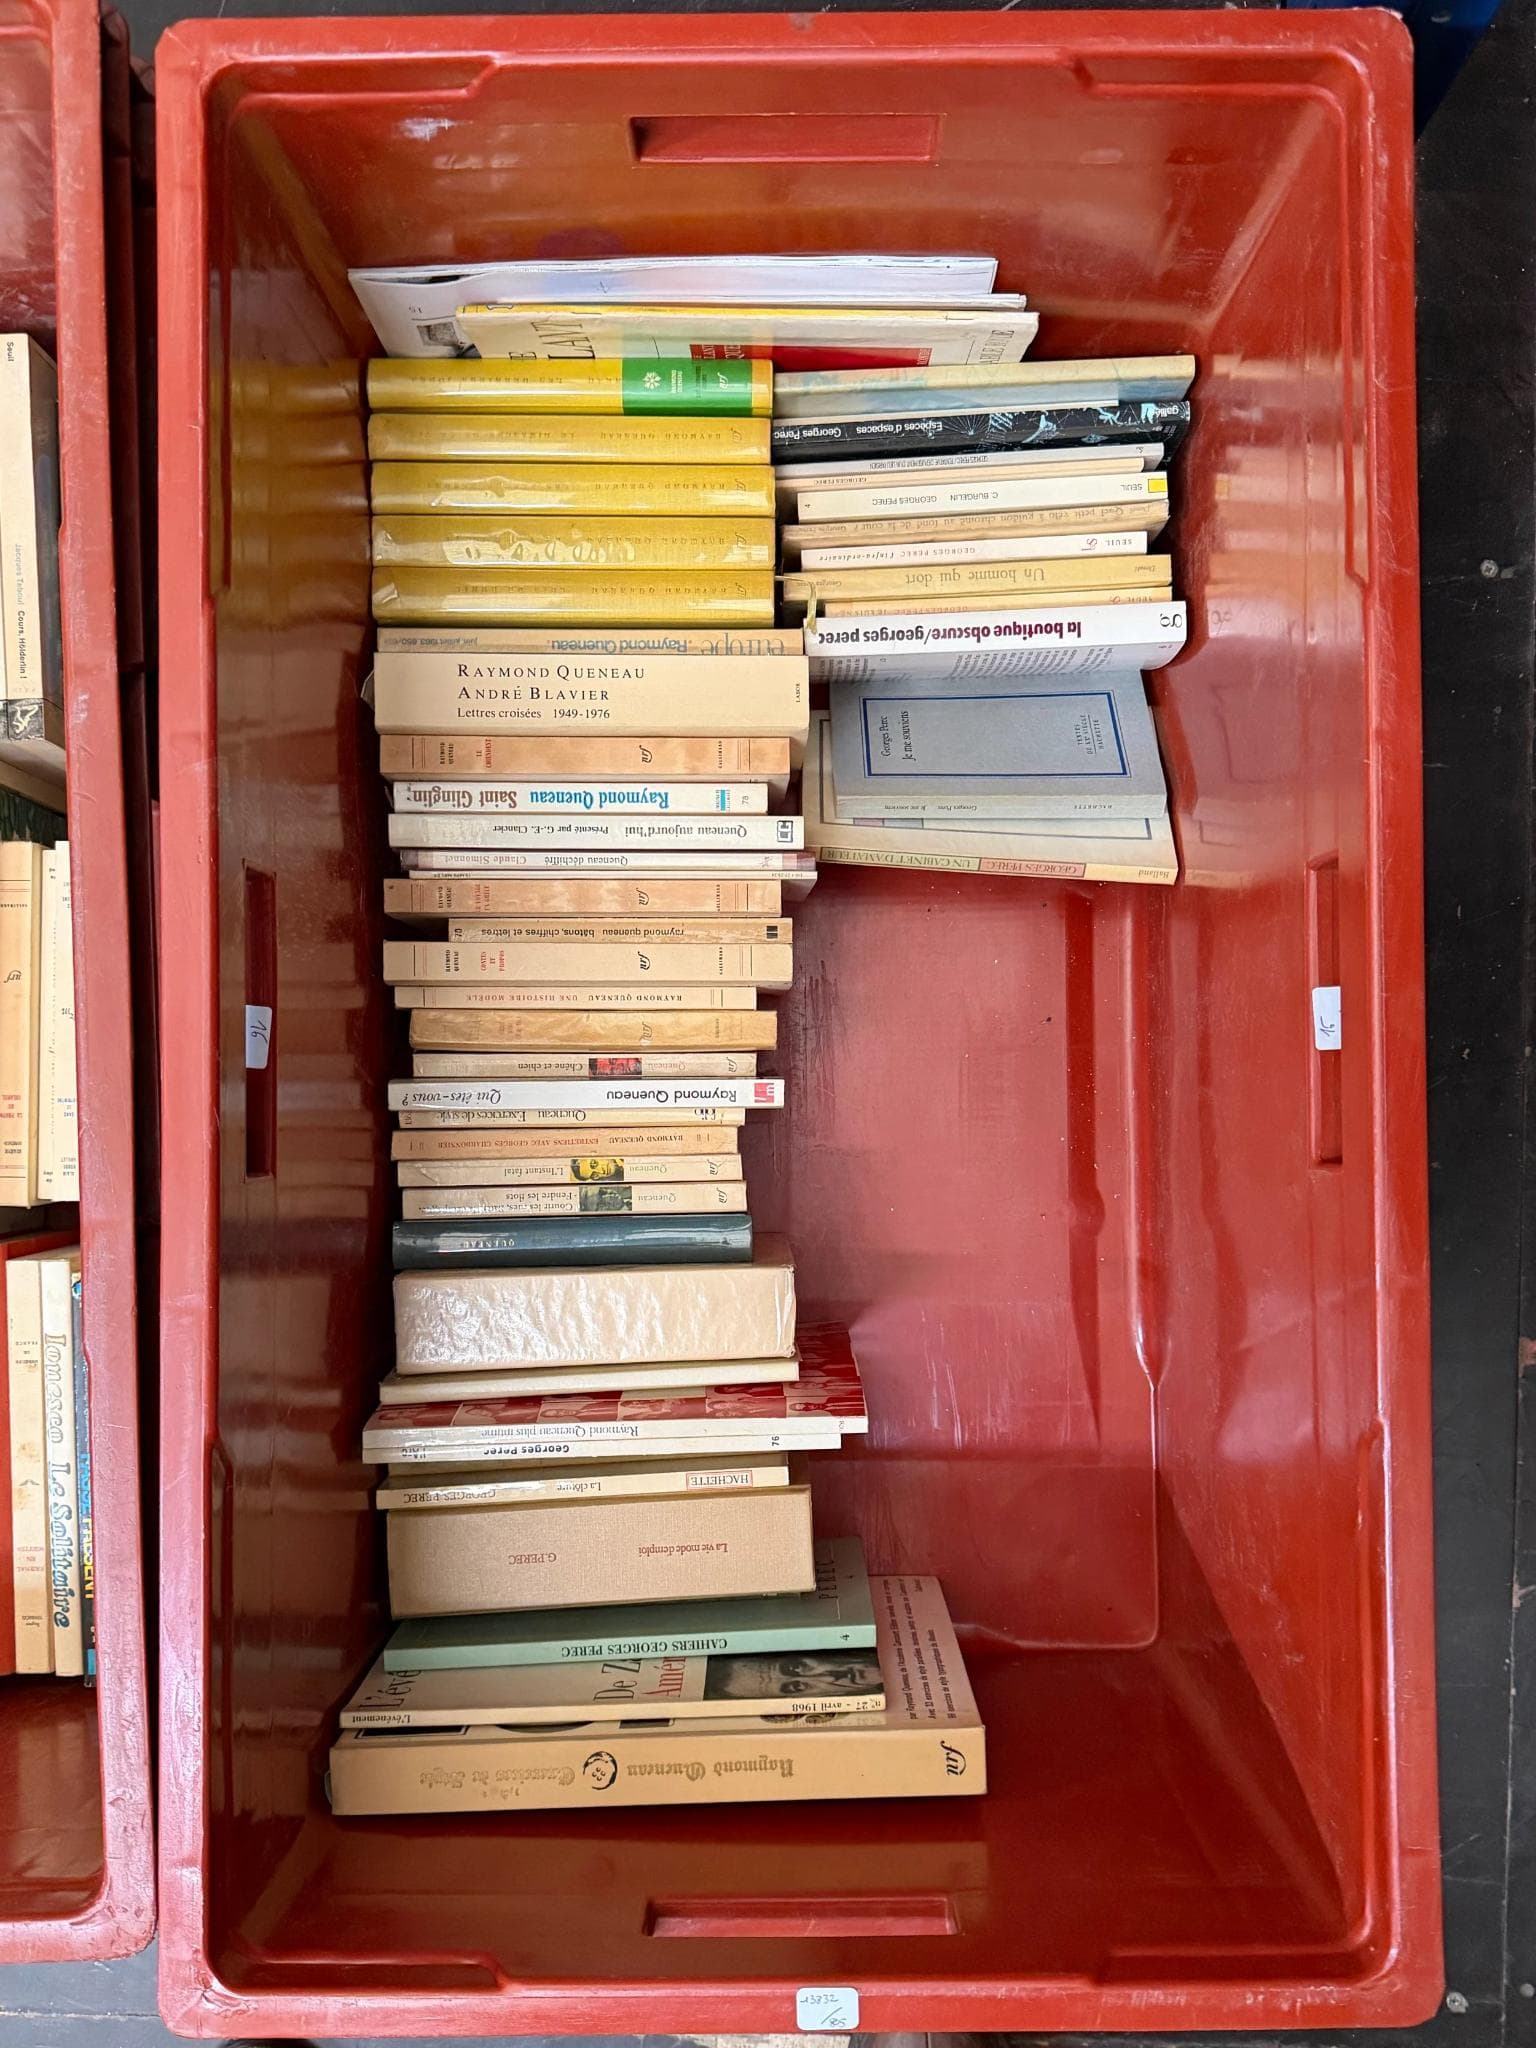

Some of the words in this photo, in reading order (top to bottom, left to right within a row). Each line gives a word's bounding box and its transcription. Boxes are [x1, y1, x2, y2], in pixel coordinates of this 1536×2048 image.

[7, 342, 15, 362] Seuil
[803, 427, 841, 439] Georges
[856, 423, 902, 436] d'espaces
[904, 421, 942, 433] Espèces
[774, 431, 800, 440] Perec
[1120, 483, 1142, 491] SEUIL
[872, 498, 897, 506] PEREC
[899, 496, 937, 504] GEORGES
[950, 491, 989, 502] BURGELIN
[900, 521, 911, 529] de
[1105, 538, 1132, 546] SEUIL
[900, 549, 928, 557] PEREC
[933, 547, 975, 555] GEORGES
[905, 573, 932, 587] dort
[940, 569, 961, 583] qui
[968, 569, 1016, 582] homme
[1024, 568, 1044, 581] Un
[16, 610, 25, 636] Cours,
[818, 627, 861, 645] perec
[994, 621, 1063, 640] boutique
[1067, 622, 1081, 638] la
[17, 637, 27, 674] Hölderlin
[457, 664, 550, 679] RAYMOND
[557, 664, 645, 681] QUENEAU
[458, 684, 522, 701] ANDRÉ
[530, 686, 610, 701] BLAVIER
[457, 708, 496, 719] Lettres
[498, 707, 541, 719] croisées
[553, 708, 610, 720] 1949-1976
[900, 711, 914, 741] souviens
[478, 791, 517, 809] Saint
[529, 788, 593, 810] Queneau
[598, 787, 669, 810] Raymond
[493, 825, 528, 835] Clancier
[557, 823, 571, 833] par
[574, 825, 609, 836] Présenté
[624, 824, 693, 840] aujourd'hui
[698, 825, 747, 839] Queneau
[444, 855, 489, 865] Simonnet
[493, 855, 526, 865] Claude
[544, 855, 584, 868] déchiffré
[587, 855, 628, 867] Queneau
[825, 850, 896, 864] D'AMATEUR
[899, 854, 951, 867] CABINET
[954, 859, 971, 868] UN
[985, 859, 1023, 872] PEREC
[1025, 862, 1078, 875] GEORGES
[1138, 869, 1169, 879] Balland
[481, 929, 510, 939] lettres
[512, 929, 523, 938] et
[526, 929, 560, 939] chiffres
[562, 927, 595, 939] bâtons,
[602, 927, 641, 937] queneau
[644, 927, 684, 939] raymond
[508, 994, 555, 1002] HISTOIRE
[558, 994, 578, 1002] UNE
[588, 993, 633, 1002] QUENEAU
[636, 994, 682, 1002] RAYMOND
[250, 1020, 267, 1044] 16
[518, 1062, 540, 1072] chien
[543, 1063, 552, 1071] et
[555, 1062, 583, 1072] Chêne
[402, 1093, 409, 1106] ?
[412, 1089, 473, 1107] êtes-vous
[475, 1089, 501, 1105] Qui
[606, 1088, 669, 1104] Queneau
[674, 1086, 736, 1104] Raymond
[462, 1109, 475, 1122] de
[477, 1109, 526, 1123] Exercices
[537, 1108, 586, 1123] Queneau
[494, 1139, 529, 1149] GEORGES
[531, 1139, 551, 1147] AVEC
[609, 1136, 642, 1144] QUENEAU
[644, 1134, 683, 1142] RAYMOND
[504, 1168, 524, 1178] fatal
[527, 1166, 564, 1177] L'Instant
[505, 1192, 525, 1203] flots
[527, 1192, 539, 1201] les
[638, 1192, 677, 1203] Queneau
[530, 1203, 542, 1213] les
[545, 1202, 573, 1212] Courir
[463, 1238, 515, 1249] QUENEAU
[44, 1333, 68, 1445] Ionesco
[516, 1426, 536, 1438] plus
[539, 1425, 586, 1438] Queneau
[589, 1424, 639, 1438] Raymond
[521, 1442, 570, 1454] Georges
[48, 1461, 71, 1497] Le
[689, 1473, 749, 1487] HACHETTE
[590, 1481, 602, 1492] La
[638, 1544, 675, 1558] d'emploi
[676, 1543, 700, 1554] mode
[702, 1543, 715, 1554] vie
[716, 1542, 728, 1553] La
[508, 1551, 557, 1565] G.PEREC
[48, 1503, 77, 1629] Solitaire
[560, 1644, 604, 1659] PEREC
[606, 1641, 668, 1656] GEORGES
[671, 1638, 728, 1653] CAHIERS
[593, 1680, 638, 1700] De
[790, 1702, 817, 1714] 1968
[819, 1701, 843, 1713] avril
[855, 1700, 868, 1712] 27
[352, 1715, 410, 1723] L'événement
[626, 1760, 706, 1782] Queneau
[713, 1754, 795, 1779] Raymond
